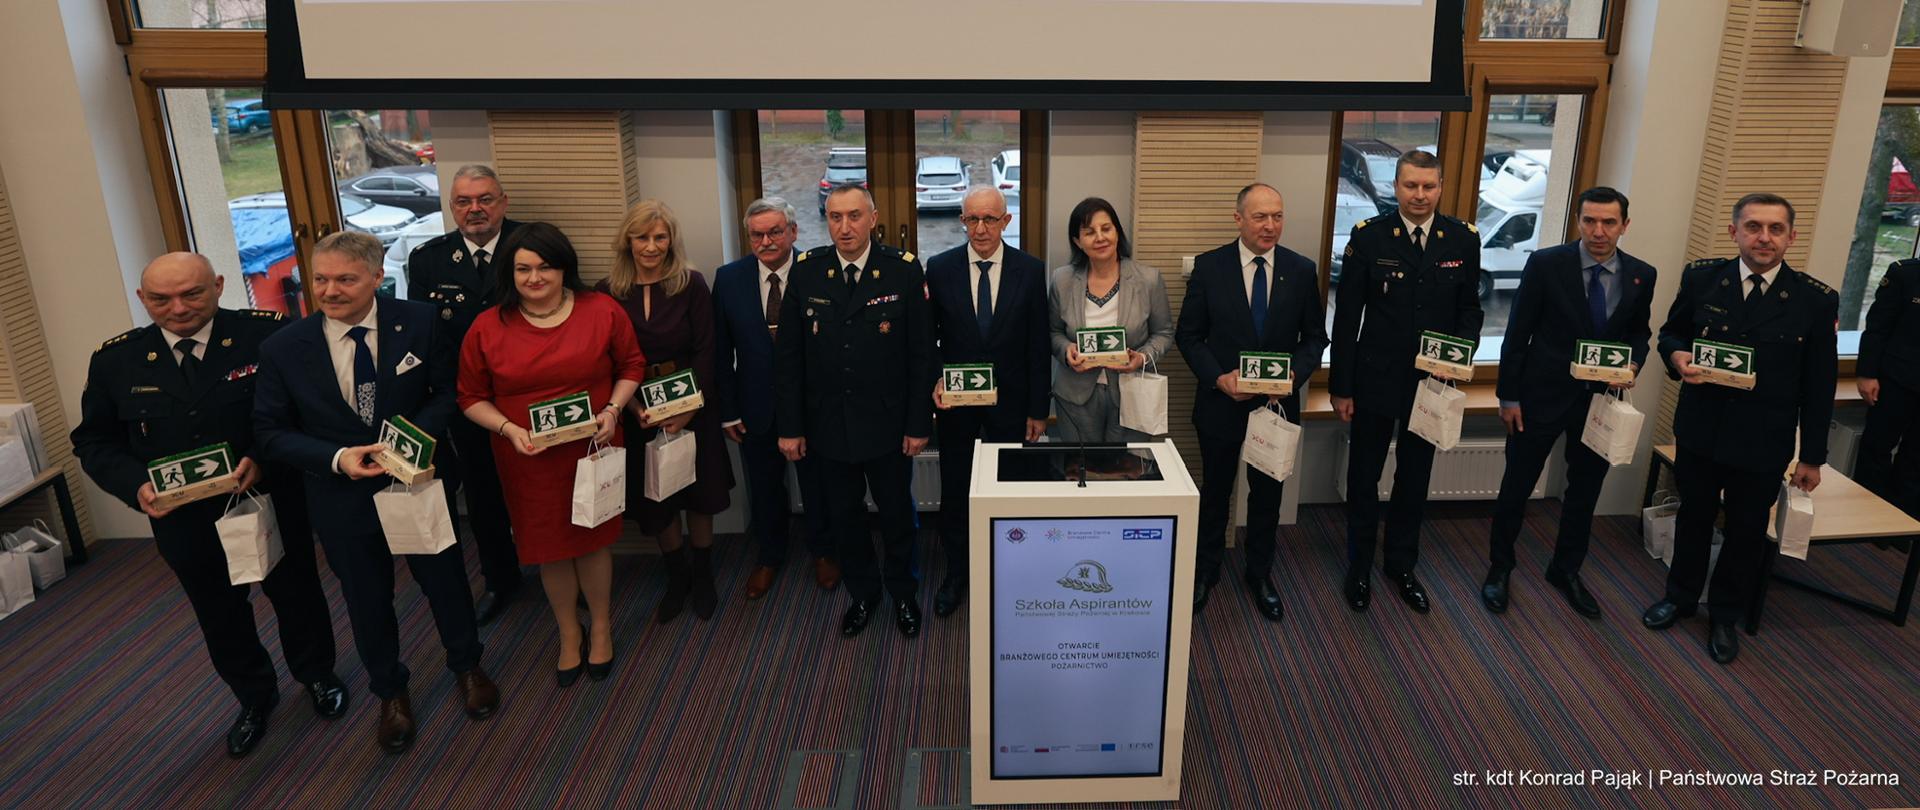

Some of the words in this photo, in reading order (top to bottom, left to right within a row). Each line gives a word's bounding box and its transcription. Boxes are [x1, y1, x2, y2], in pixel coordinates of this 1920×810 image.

[1015, 599, 1065, 611] Szkoła
[1069, 598, 1153, 611] Aspirantów
[1057, 642, 1100, 650] OTWARCIE
[1000, 652, 1058, 661] BRANŻOWEGO
[1059, 652, 1099, 660] CENTRUM
[1101, 650, 1160, 661] UMIEJĘTNOŚCI
